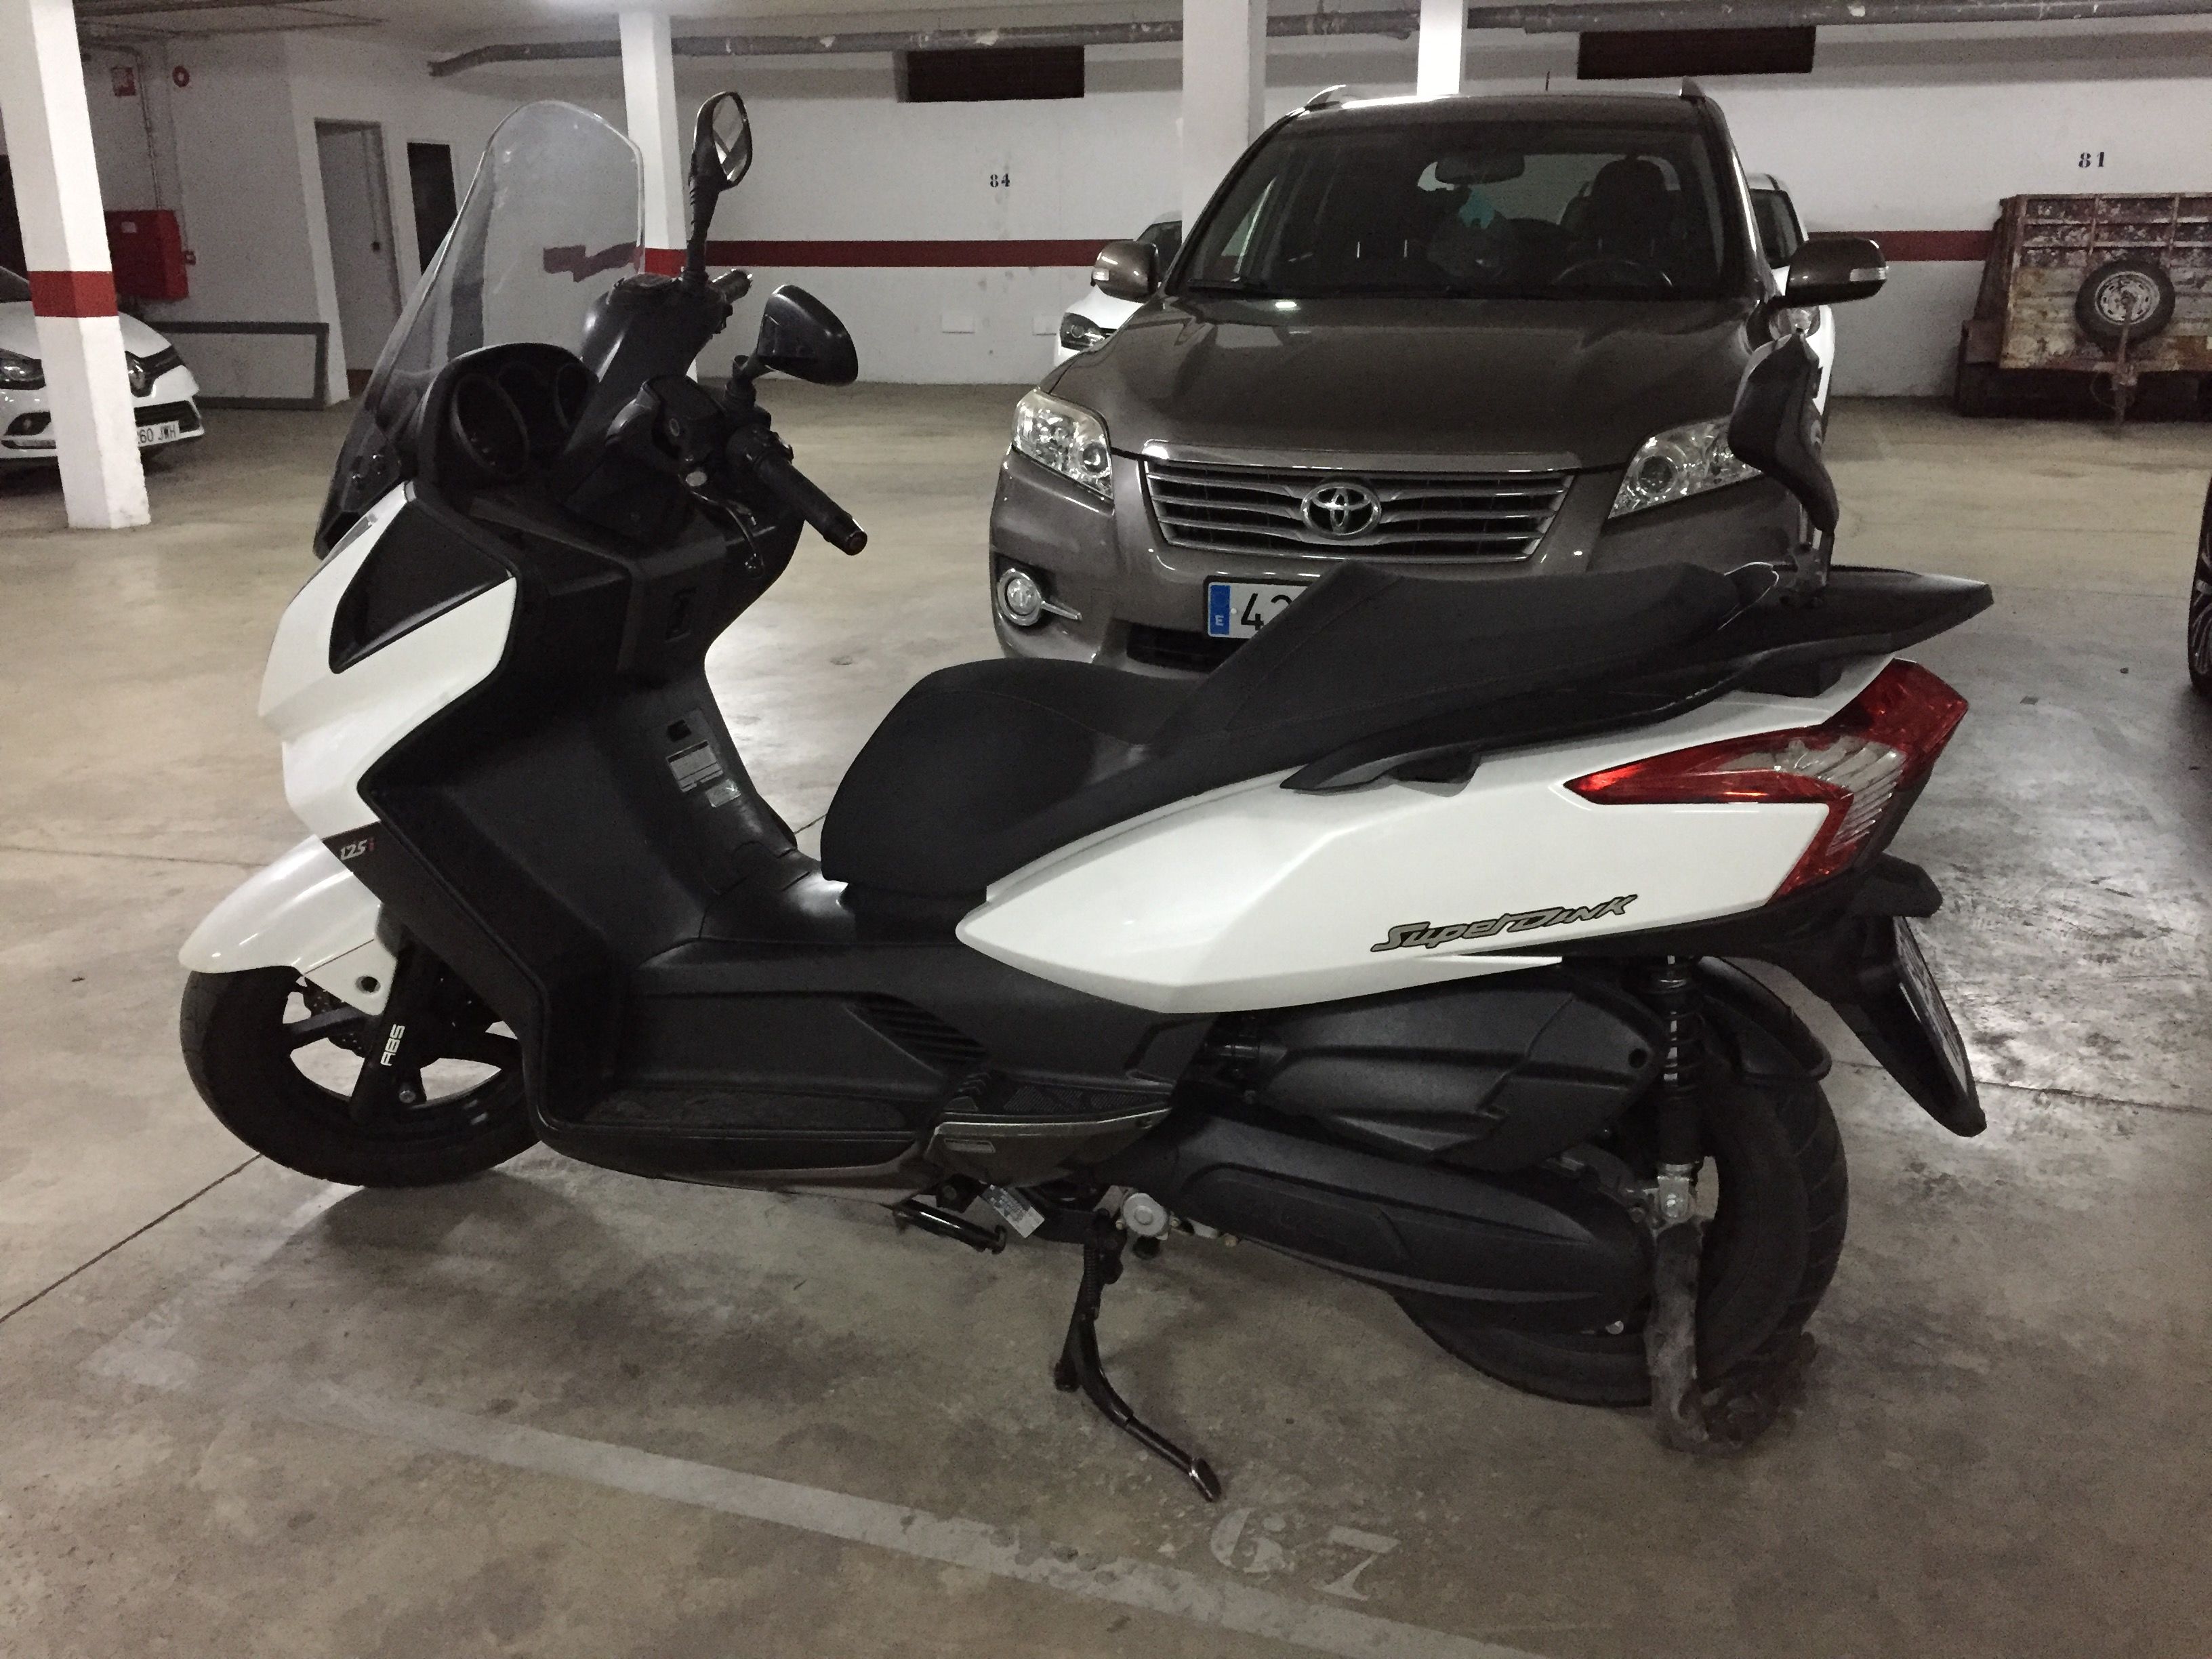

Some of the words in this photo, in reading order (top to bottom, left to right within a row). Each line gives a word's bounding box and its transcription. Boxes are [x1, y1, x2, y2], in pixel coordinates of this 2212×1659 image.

[2078, 151, 2105, 168] 81
[989, 173, 1010, 188] 84
[137, 428, 154, 443] 60
[380, 1023, 405, 1066] ABS
